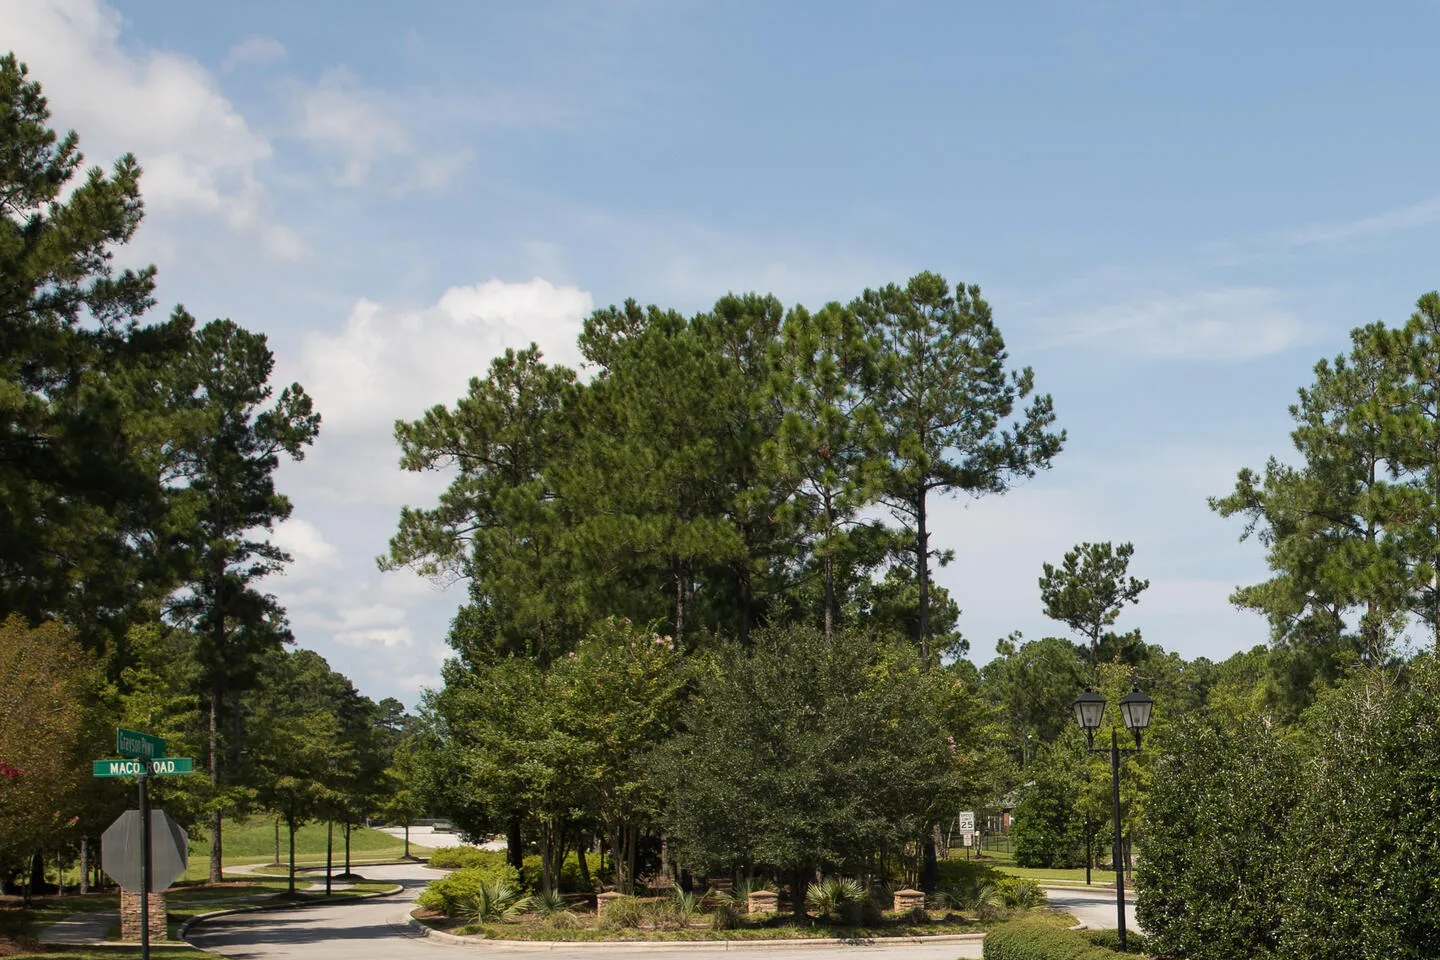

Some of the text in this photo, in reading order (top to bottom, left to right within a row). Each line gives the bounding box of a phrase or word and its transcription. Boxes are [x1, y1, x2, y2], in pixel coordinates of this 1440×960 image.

[110, 761, 175, 775] MACO ROAD
[961, 821, 973, 829] 25
